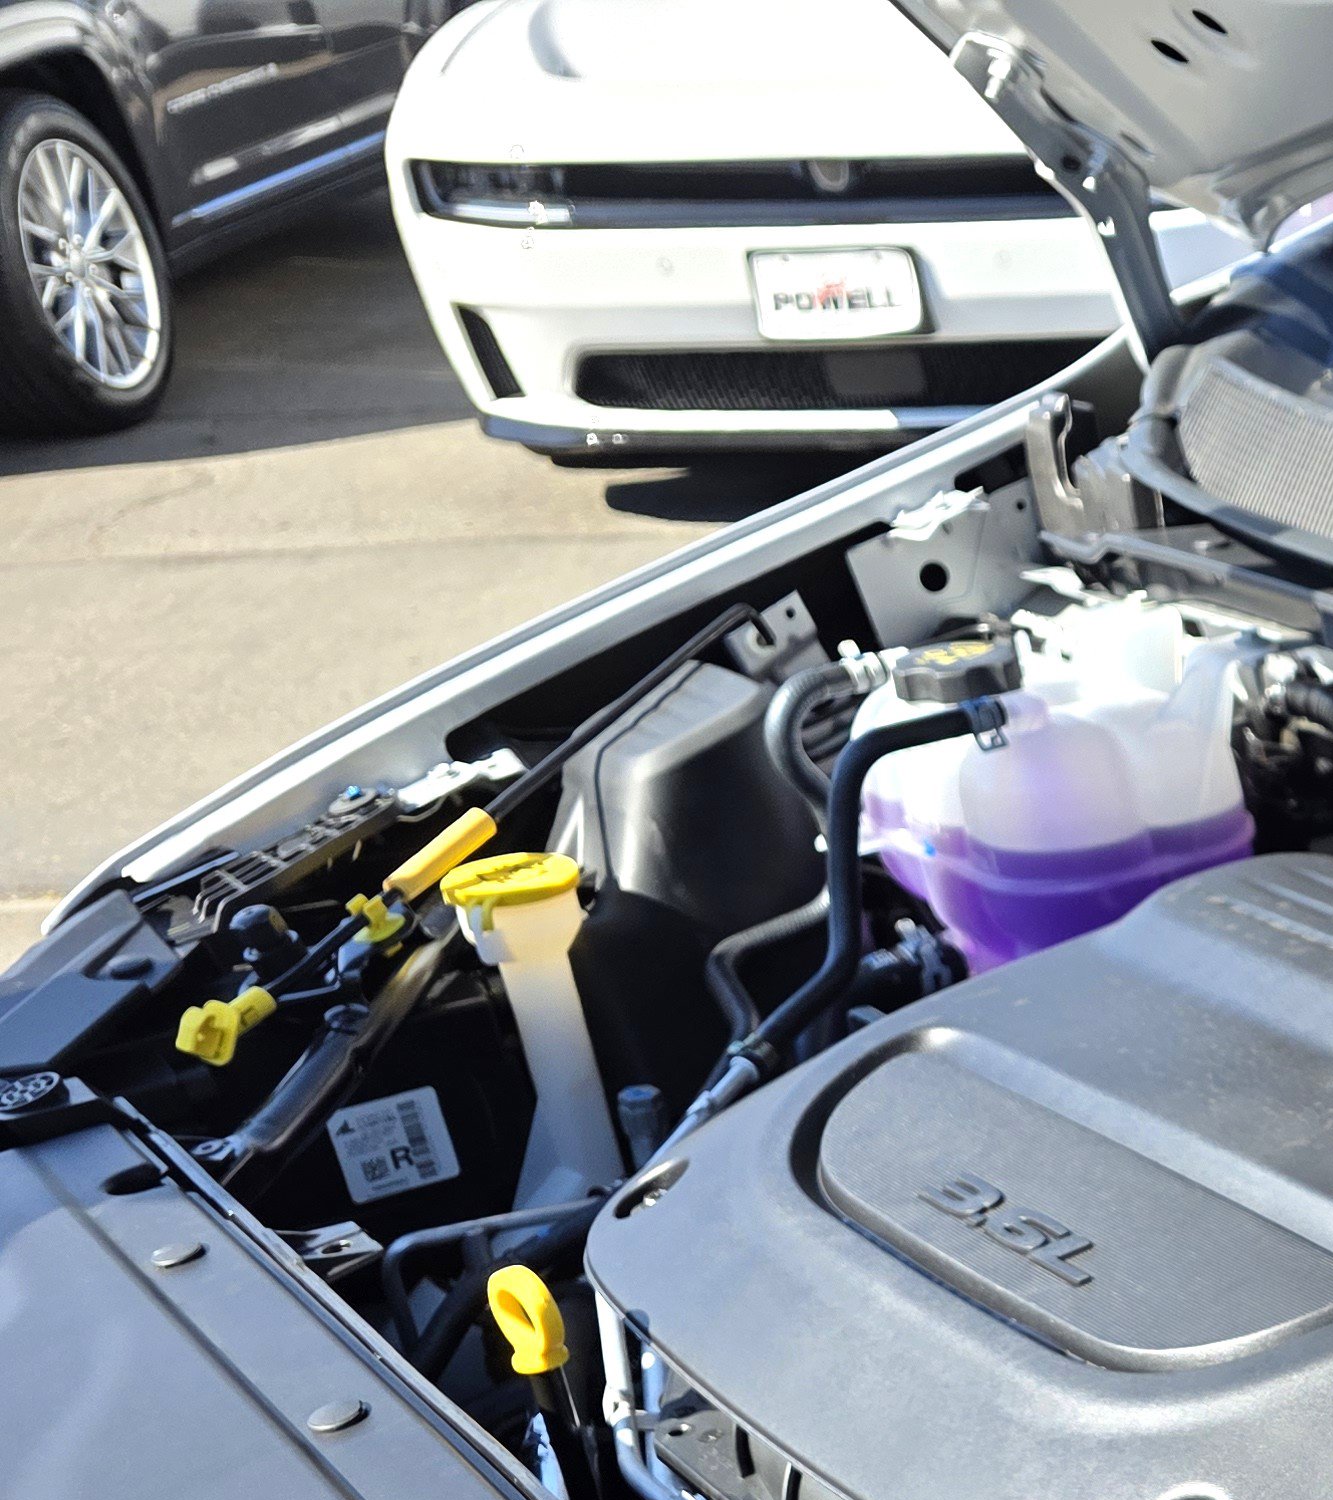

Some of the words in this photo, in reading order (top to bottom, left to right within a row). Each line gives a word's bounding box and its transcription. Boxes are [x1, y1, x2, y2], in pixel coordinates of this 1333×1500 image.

[773, 285, 902, 311] POWELL
[390, 1145, 414, 1171] R
[917, 1171, 1095, 1287] 3.6L
